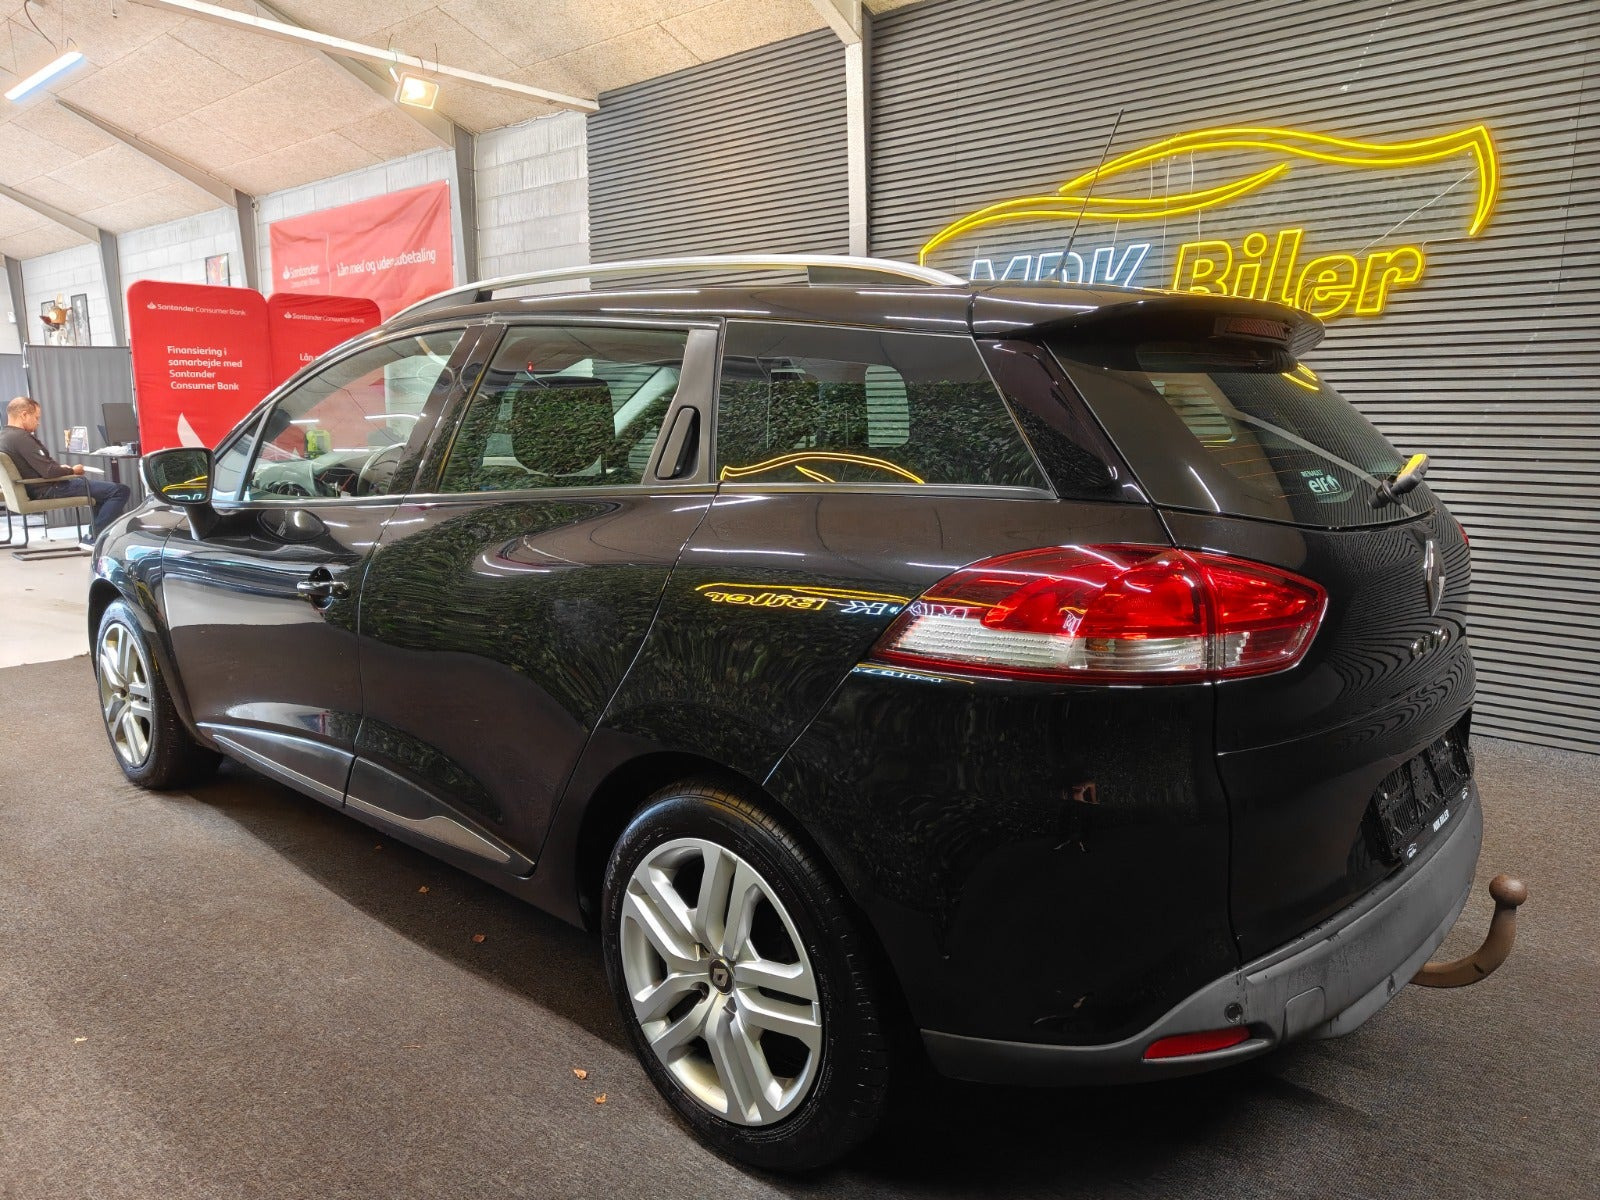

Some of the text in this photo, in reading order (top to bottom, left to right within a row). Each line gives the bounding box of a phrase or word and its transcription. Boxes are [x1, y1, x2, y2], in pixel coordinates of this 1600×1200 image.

[365, 260, 376, 276] og
[1173, 229, 1424, 316] Biler
[157, 304, 194, 312] Santander
[195, 306, 228, 314] Consumer
[167, 345, 222, 357] Finansiering
[299, 352, 314, 361] Lån
[168, 358, 243, 369] samarbejde med
[169, 369, 216, 379] Santander
[170, 381, 239, 390] Consumer Bank
[1308, 477, 1330, 493] elf
